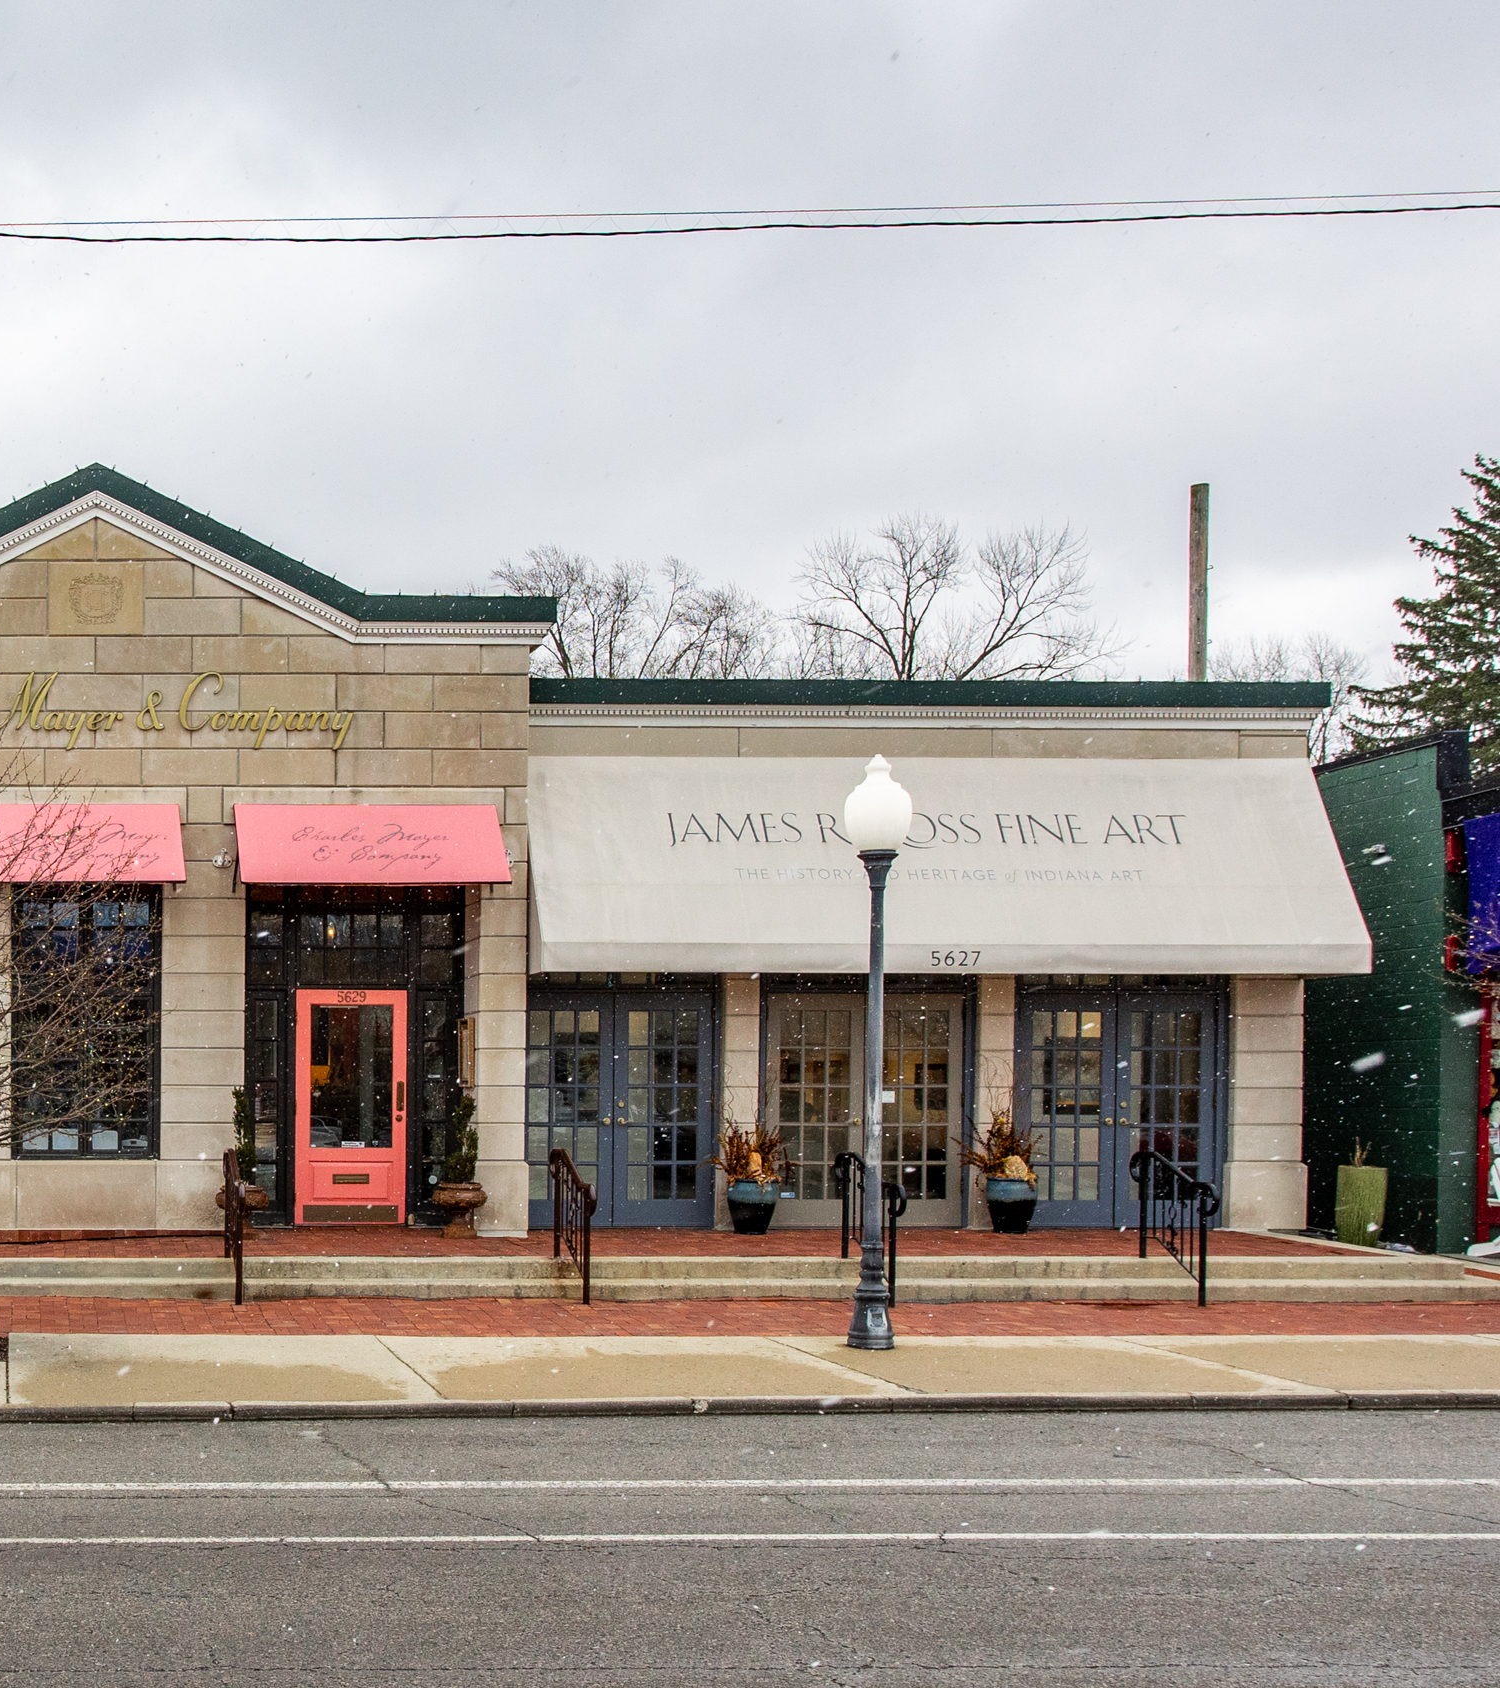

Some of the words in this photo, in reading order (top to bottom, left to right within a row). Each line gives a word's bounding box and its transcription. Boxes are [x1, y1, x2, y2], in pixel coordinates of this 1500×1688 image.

[135, 690, 165, 731] &
[179, 670, 354, 751] Company
[291, 826, 367, 842] Charles
[376, 823, 450, 851] Mayer
[666, 812, 803, 847] JAMES
[902, 812, 982, 849] OSS
[995, 813, 1090, 844] FINE
[1102, 813, 1187, 846] ART
[348, 845, 443, 872] Company
[735, 867, 770, 880] THE
[777, 868, 854, 881] HISTORY
[907, 868, 997, 881] HERITAGE
[1004, 868, 1020, 884] of
[1024, 869, 1104, 882] INDIANA
[1110, 869, 1144, 882] ART
[930, 949, 982, 967] 5627
[336, 990, 367, 1004] 5629
